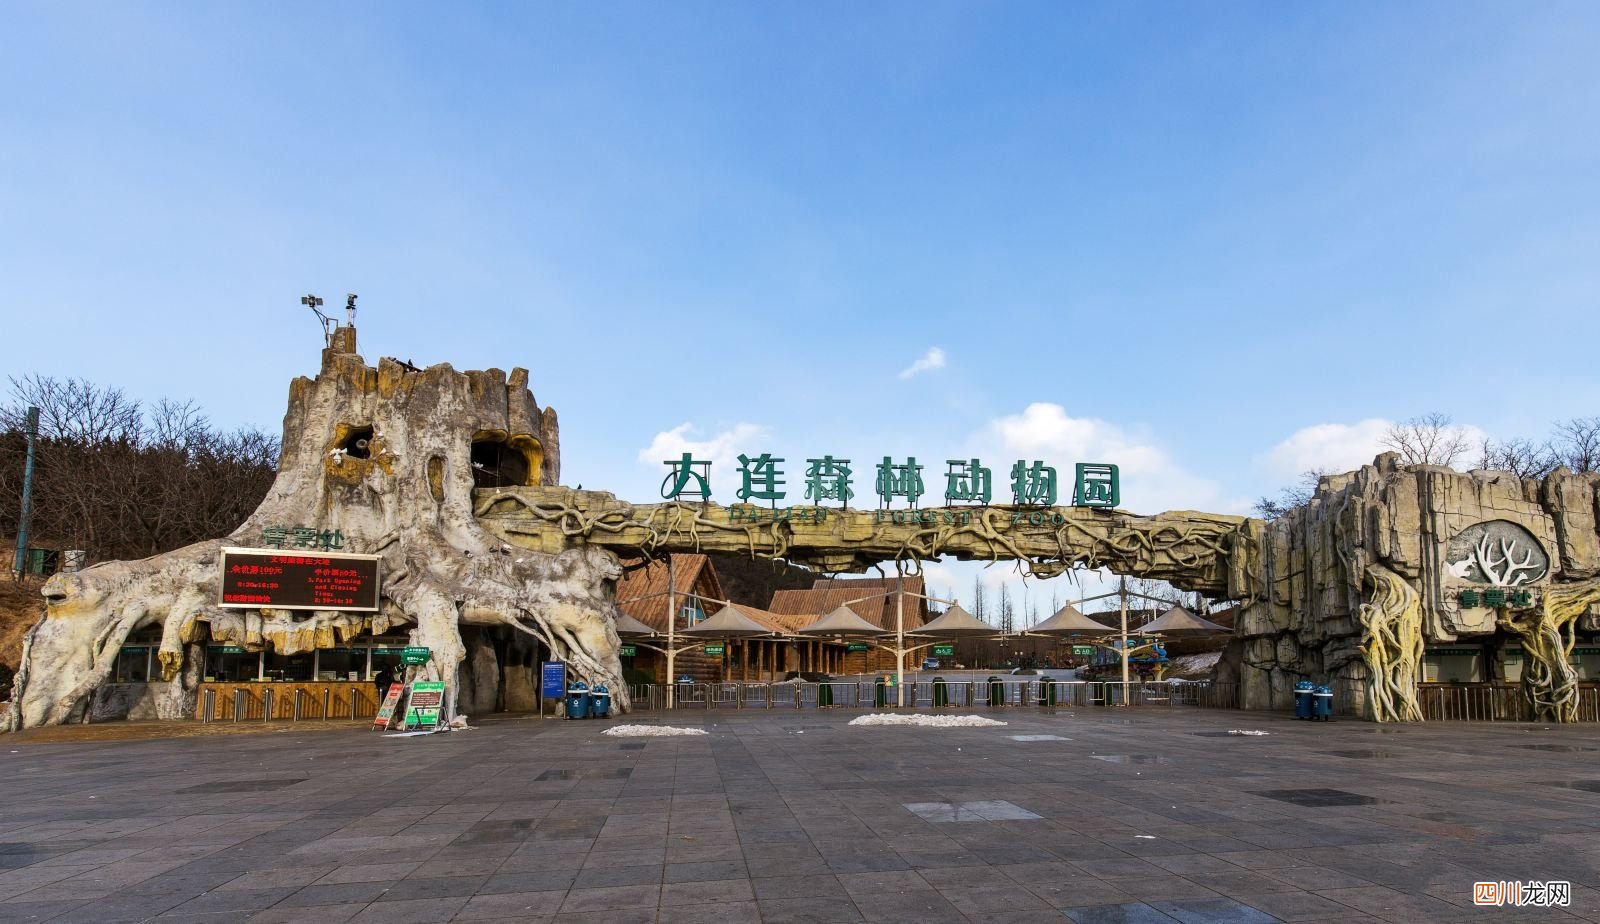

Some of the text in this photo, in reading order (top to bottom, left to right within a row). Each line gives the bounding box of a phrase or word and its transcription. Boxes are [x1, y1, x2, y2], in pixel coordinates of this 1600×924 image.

[661, 453, 1121, 508] 大连森林动物园
[875, 508, 972, 524] FOREST
[1011, 511, 1066, 526] ZOO
[263, 527, 345, 549] 售票处
[1461, 589, 1532, 609] 售票处
